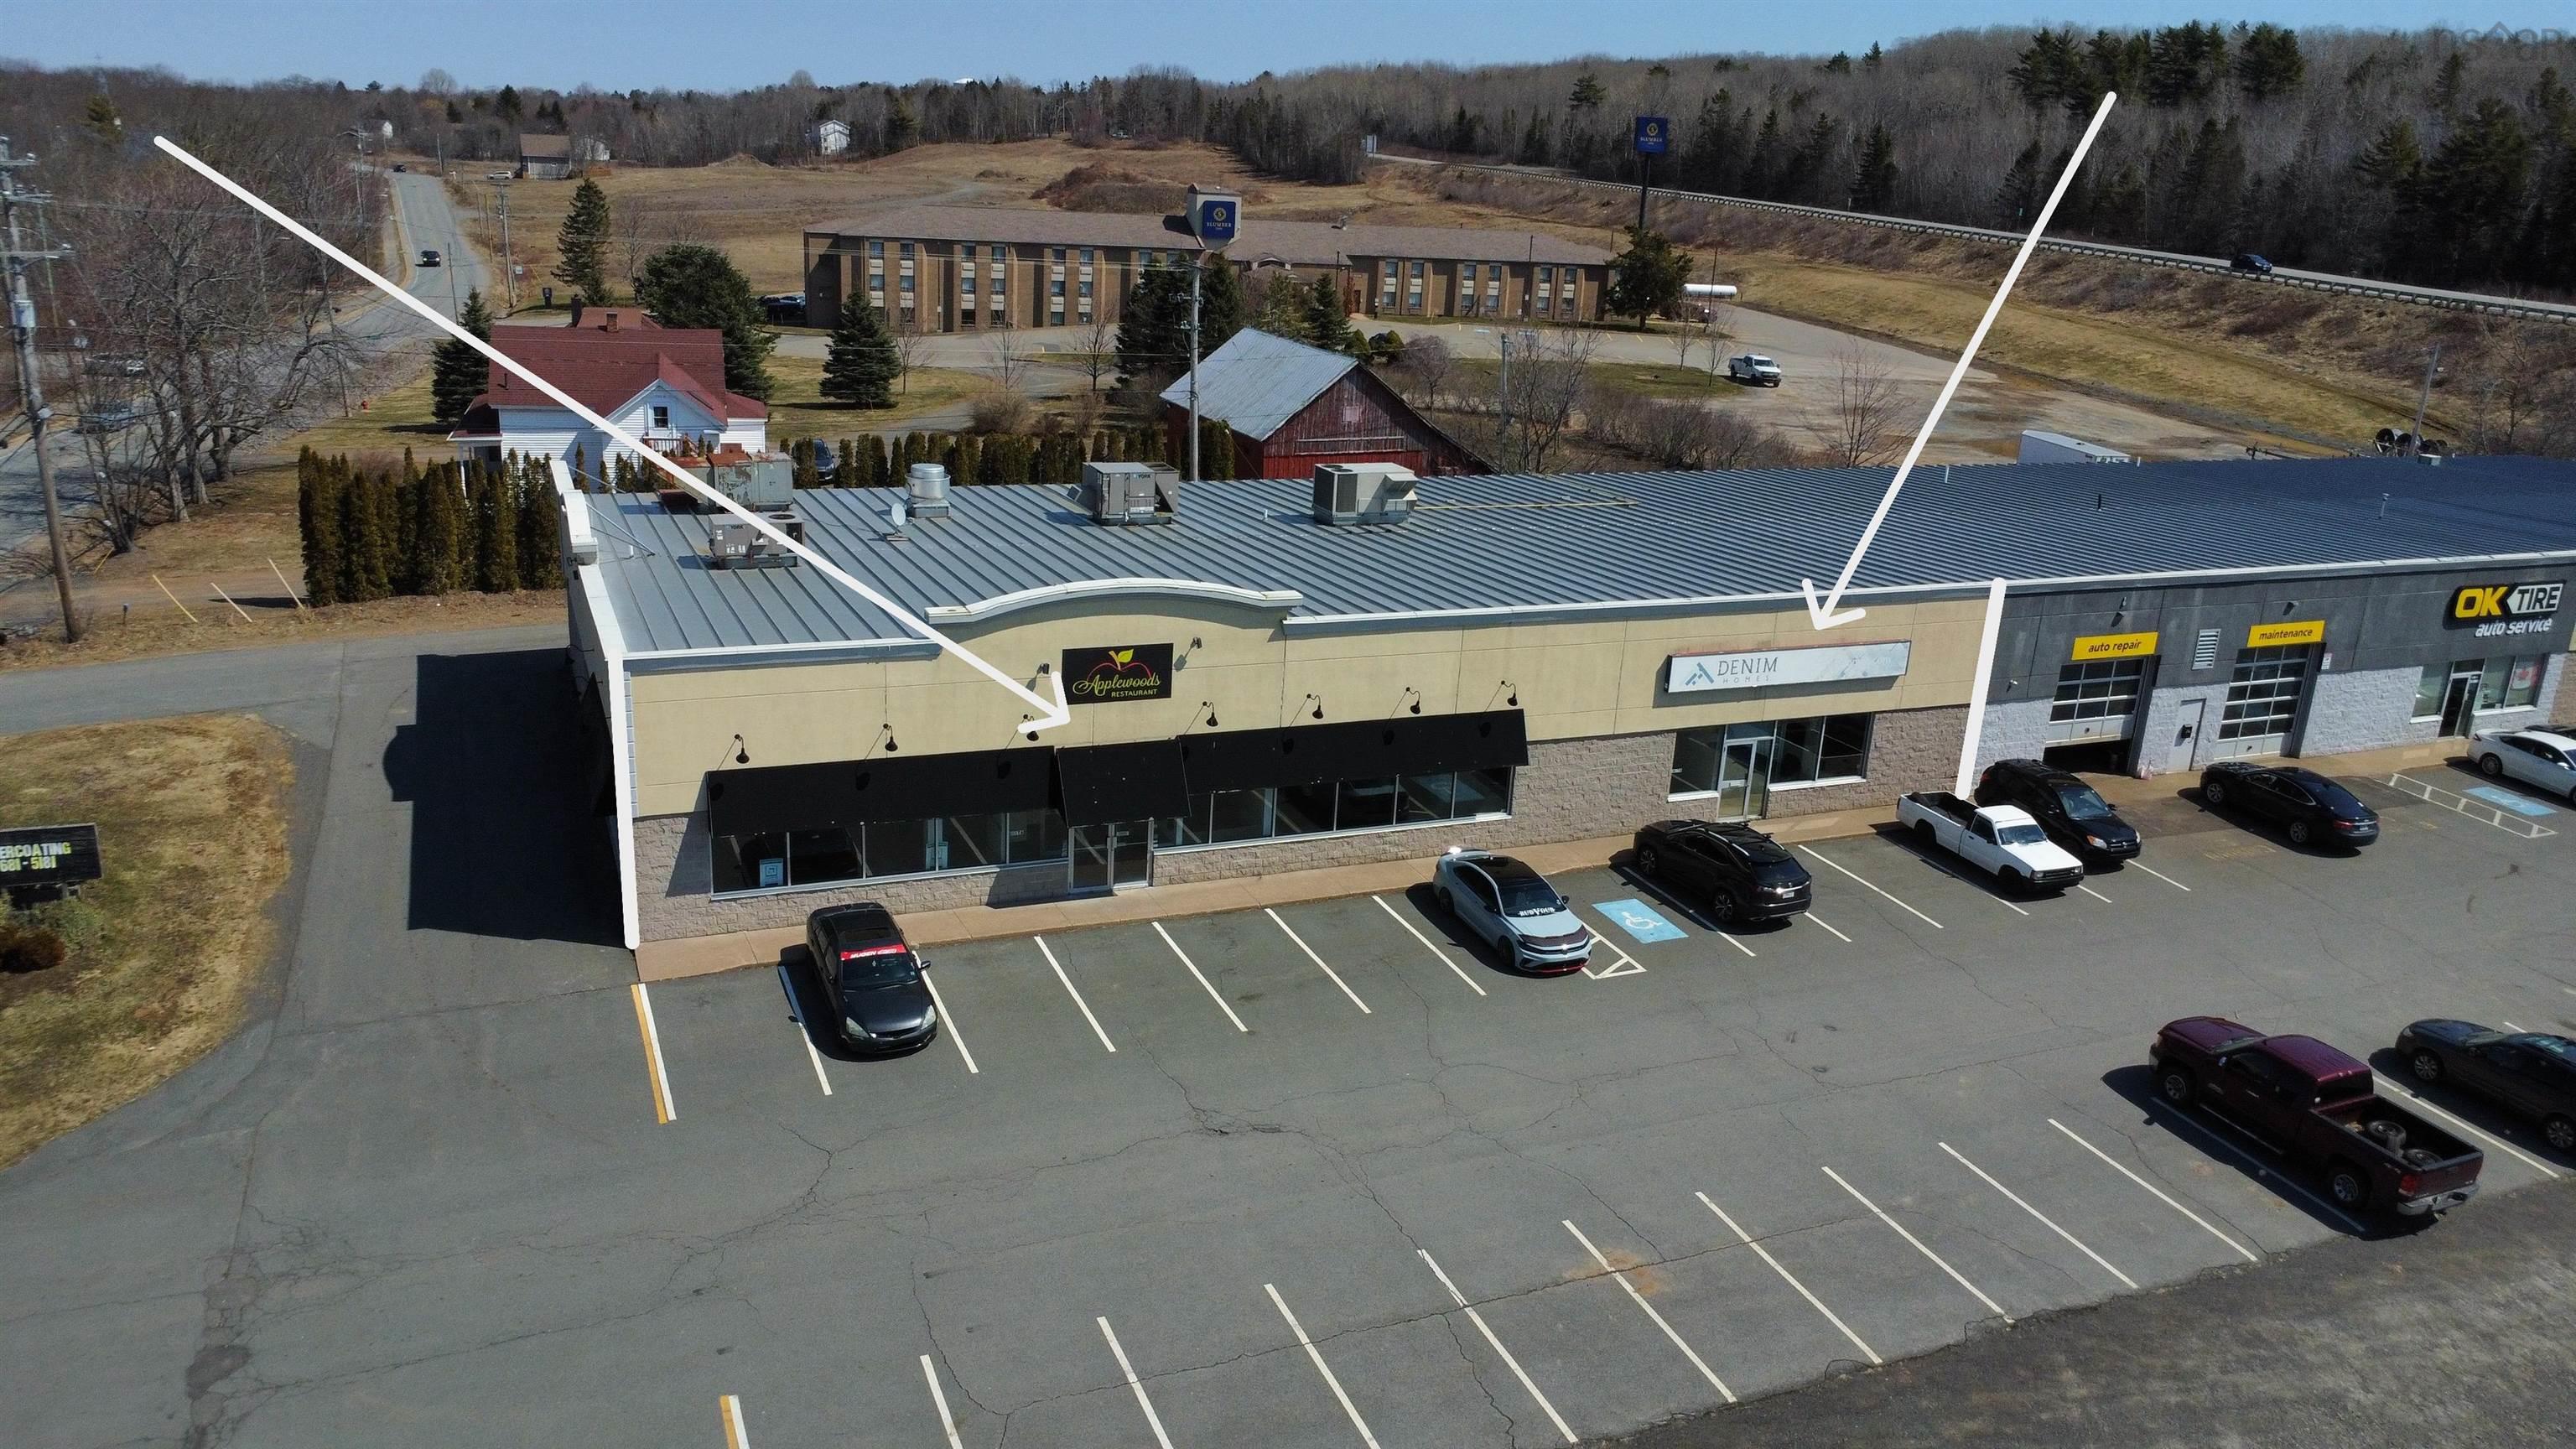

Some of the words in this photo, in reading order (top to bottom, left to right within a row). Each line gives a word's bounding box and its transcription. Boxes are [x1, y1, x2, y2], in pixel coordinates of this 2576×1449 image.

[2455, 586, 2508, 618] OK
[2516, 586, 2560, 612] TIRE
[2475, 620, 2506, 637] auto
[2506, 615, 2553, 635] service
[2259, 628, 2314, 641] maintenance
[2088, 641, 2111, 652] auto
[2112, 638, 2142, 653] repair
[1717, 657, 1778, 677] DENIM
[1072, 672, 1161, 697] Applewoods
[1722, 675, 1769, 684] HOMES
[1111, 688, 1158, 698] RESTAURANT
[849, 950, 877, 959] MUGEN
